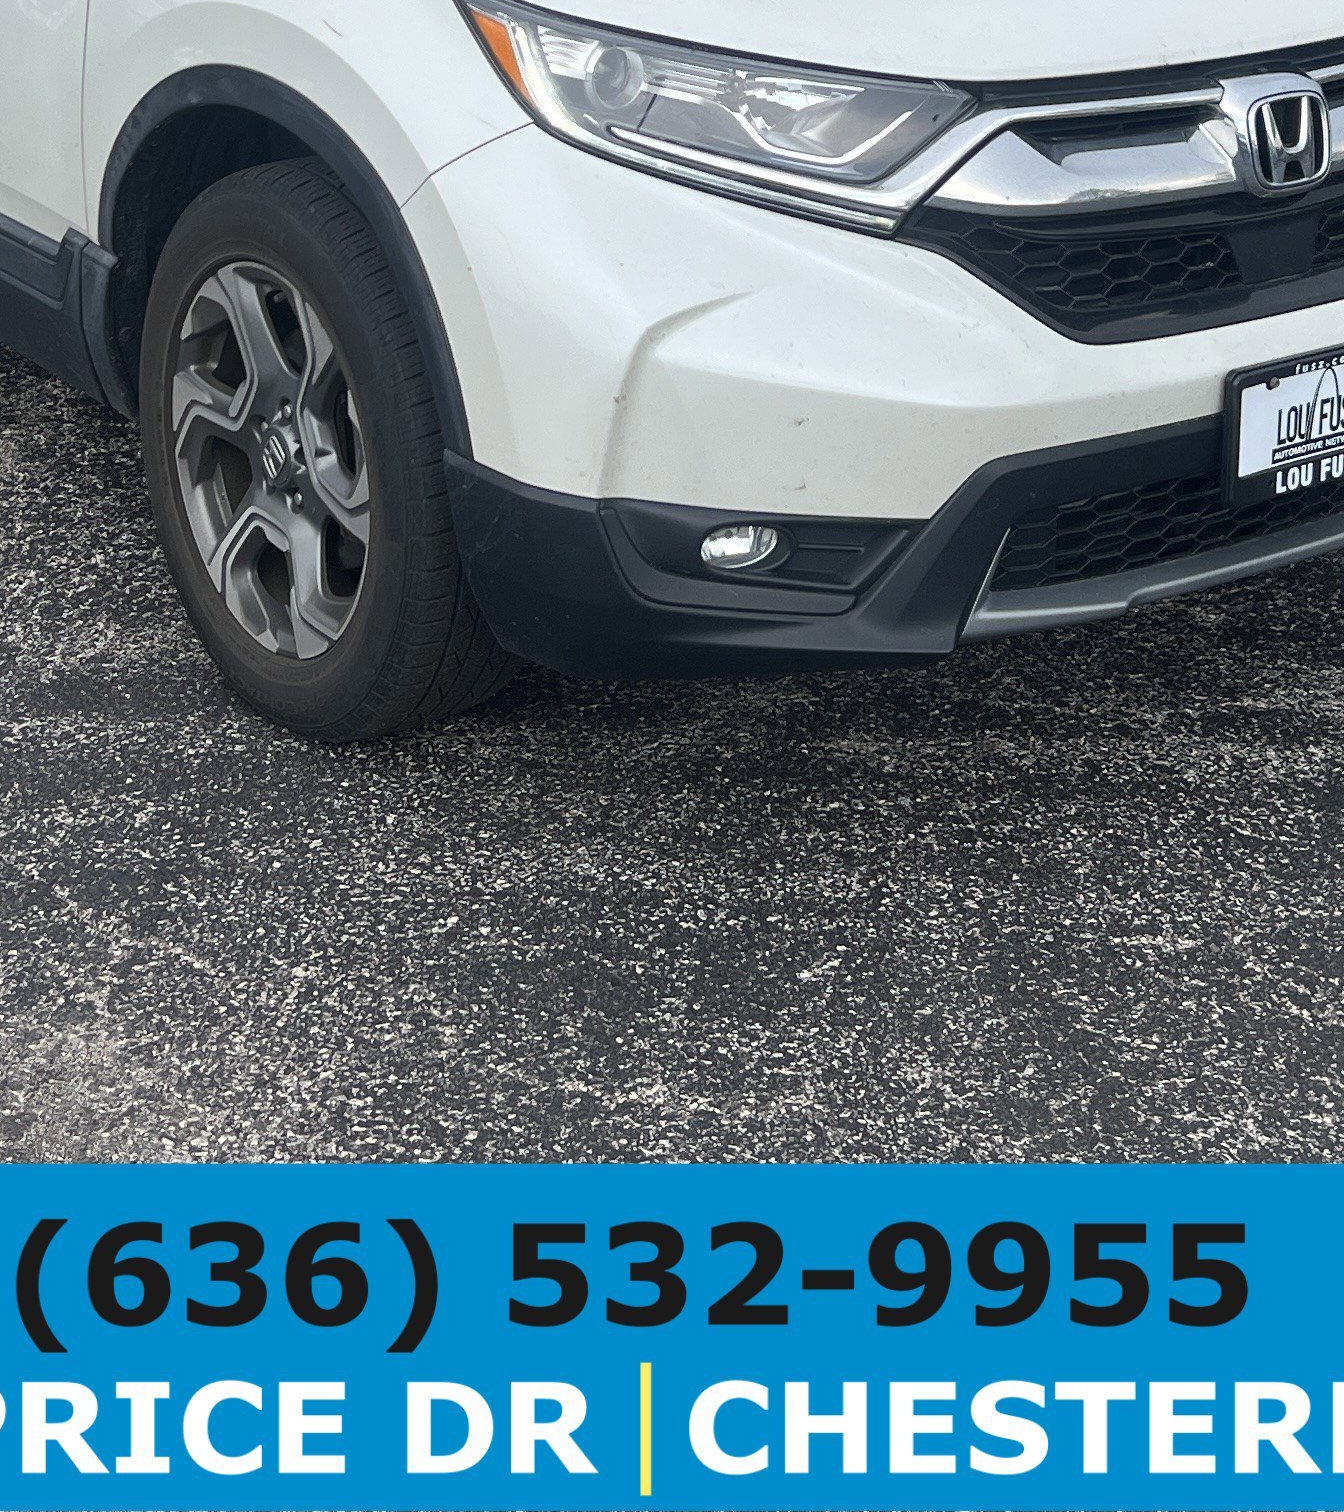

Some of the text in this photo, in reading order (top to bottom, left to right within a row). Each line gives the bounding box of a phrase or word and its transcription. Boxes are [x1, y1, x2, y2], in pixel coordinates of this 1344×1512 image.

[1277, 401, 1311, 446] LOU
[1273, 439, 1323, 461] AUTOMOTIVE
[1275, 462, 1313, 494] LOU
